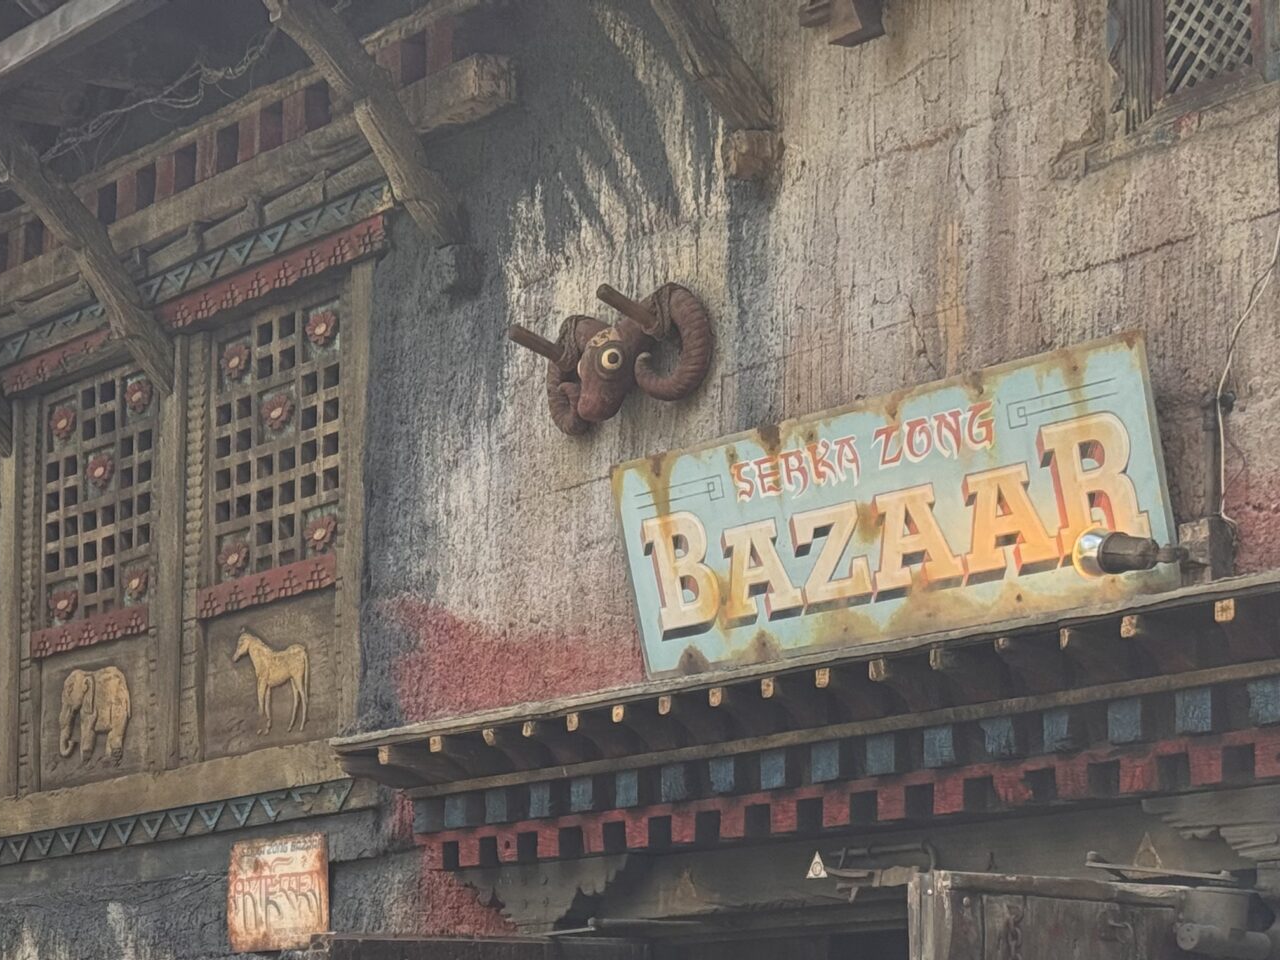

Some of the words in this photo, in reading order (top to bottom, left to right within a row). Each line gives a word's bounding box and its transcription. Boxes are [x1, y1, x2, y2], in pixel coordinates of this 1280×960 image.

[641, 411, 1152, 642] BAZAAR
[730, 434, 862, 503] SERKA
[871, 399, 998, 467] ZONG
